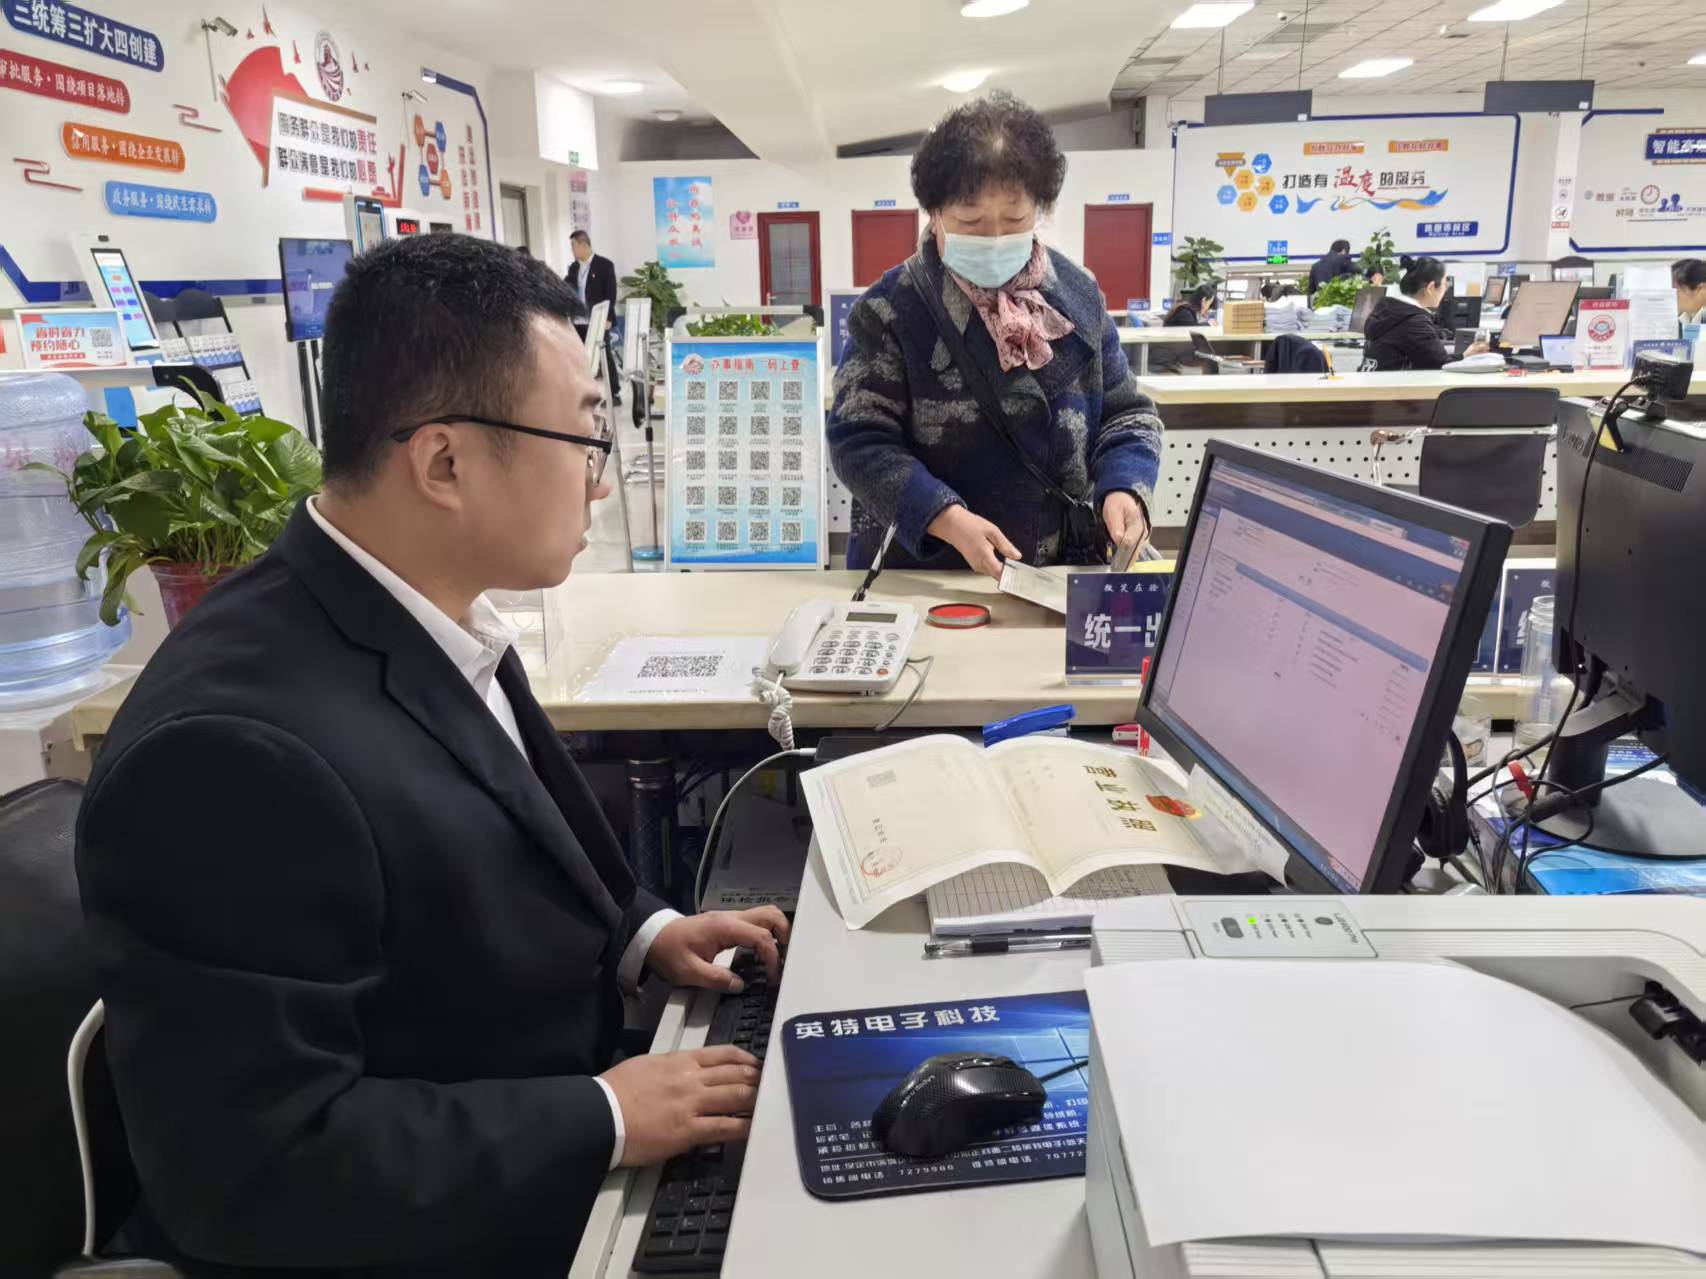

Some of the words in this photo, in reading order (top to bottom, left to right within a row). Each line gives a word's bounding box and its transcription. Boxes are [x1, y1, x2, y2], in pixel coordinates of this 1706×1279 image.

[1282, 165, 1426, 197] 打造有温度的服务
[795, 1005, 1000, 1040] 英特电子科技
